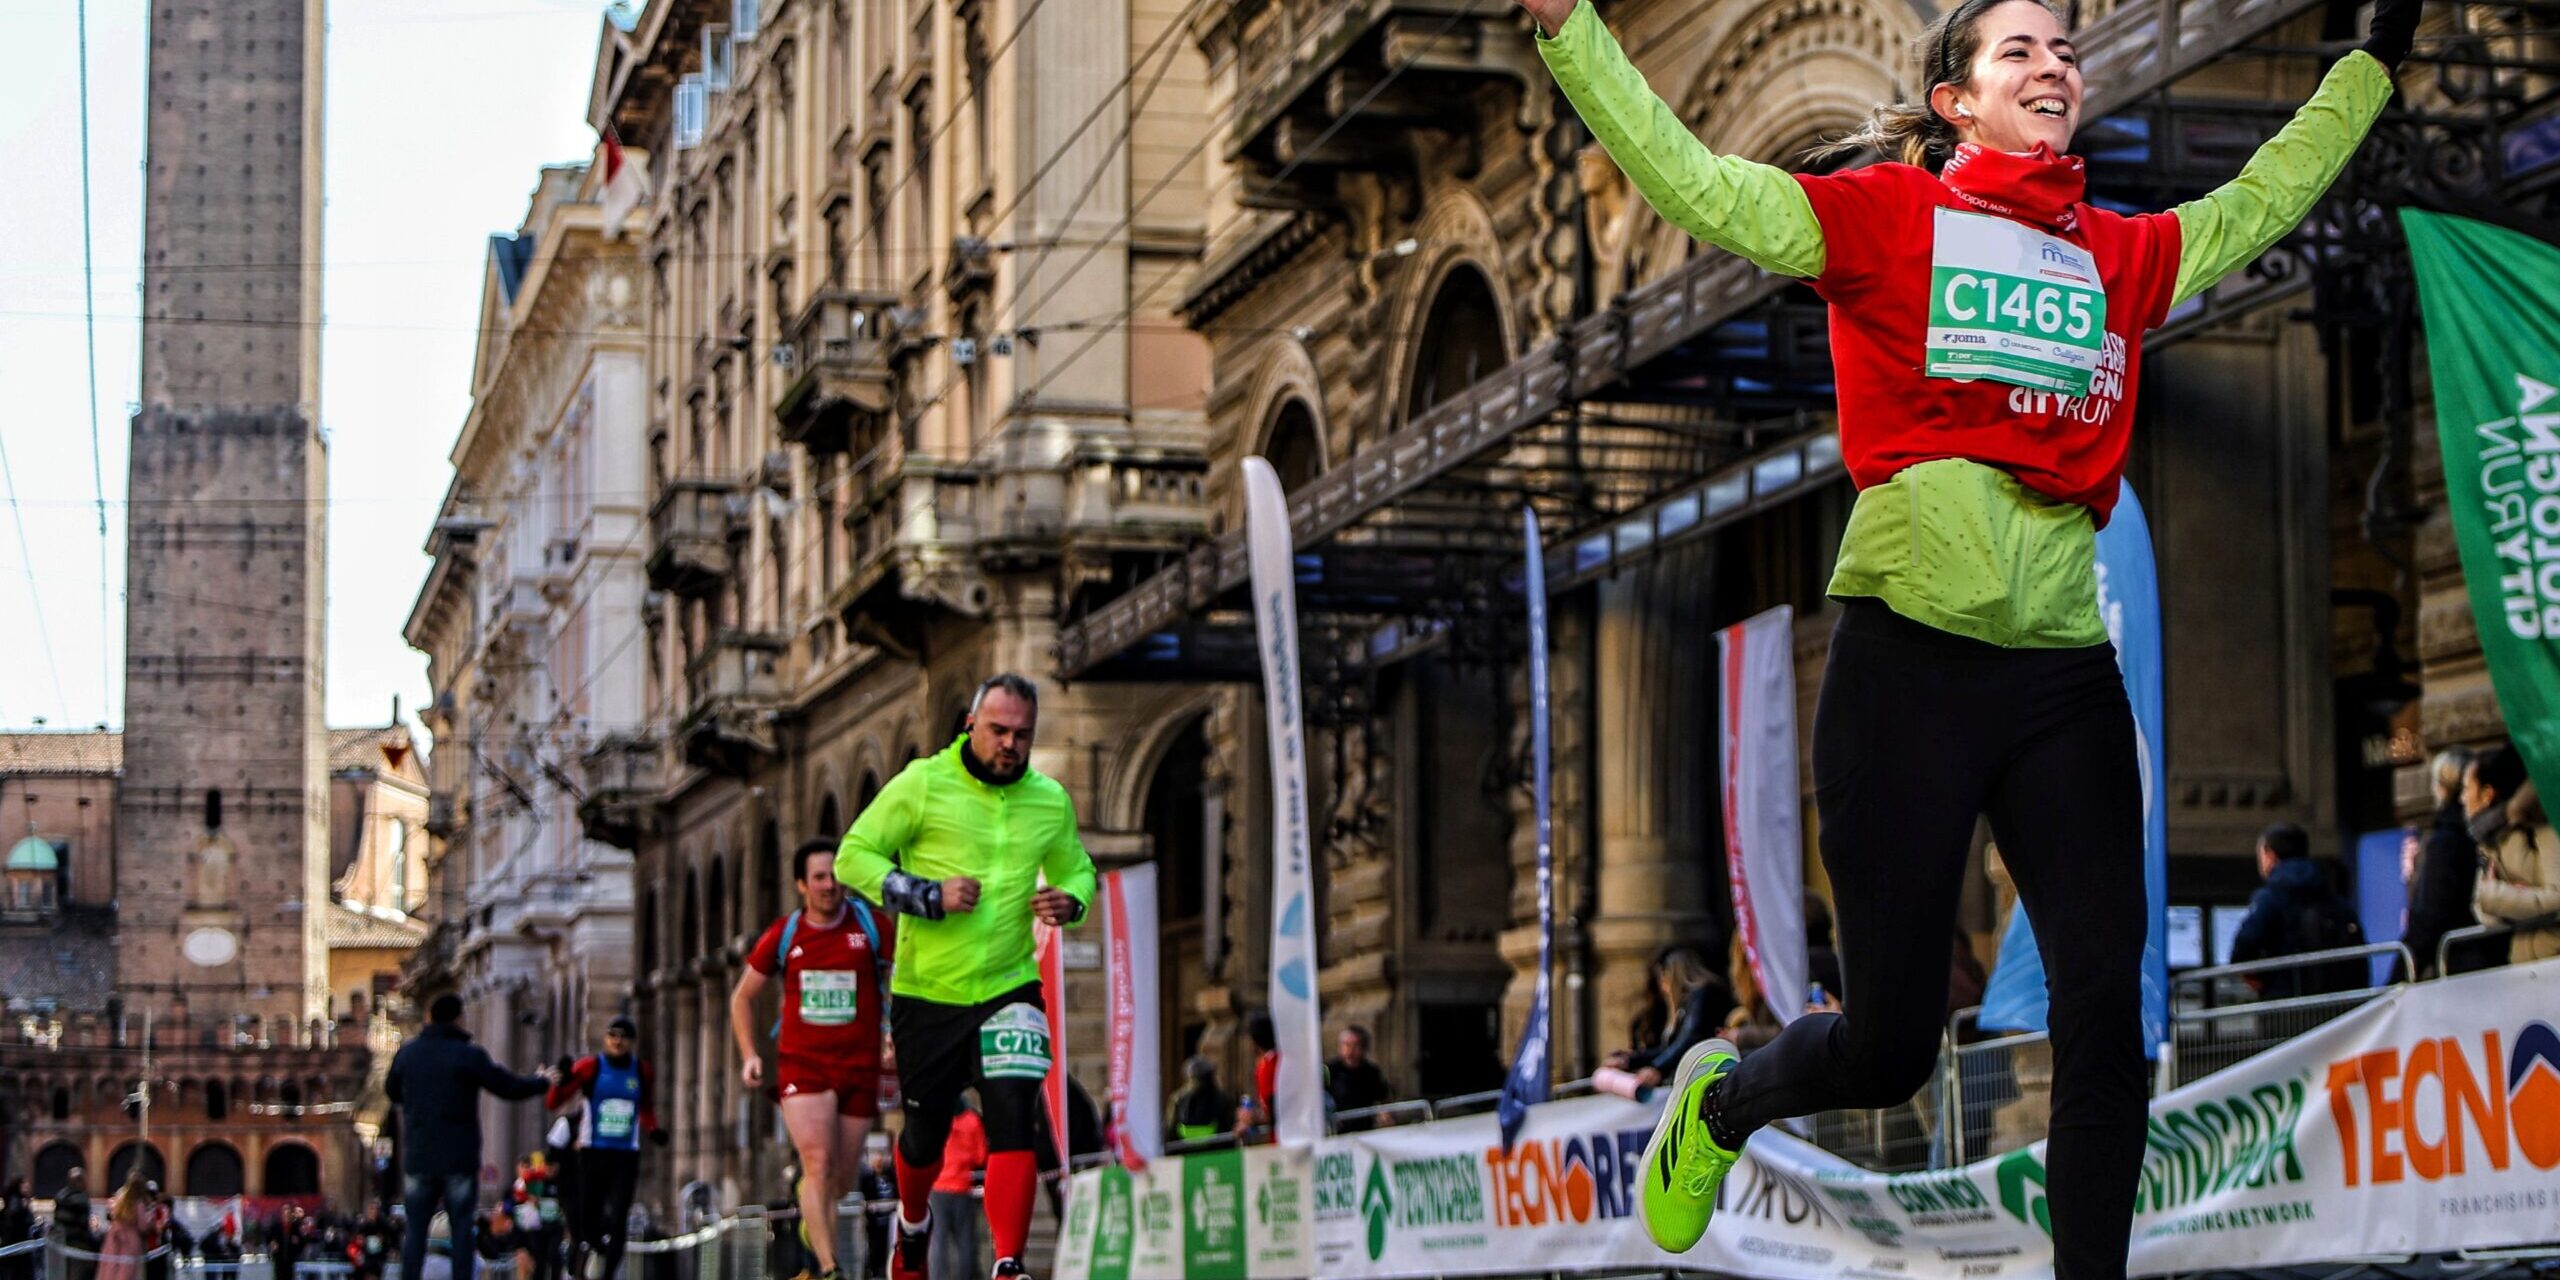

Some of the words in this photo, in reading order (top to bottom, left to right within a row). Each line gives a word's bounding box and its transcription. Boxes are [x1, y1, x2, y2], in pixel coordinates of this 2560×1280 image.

[1944, 273, 2092, 339] C1465
[993, 1031, 1044, 1055] C712
[1486, 1128, 1655, 1227] TECNORE
[2228, 1200, 2316, 1228] NETWORK
